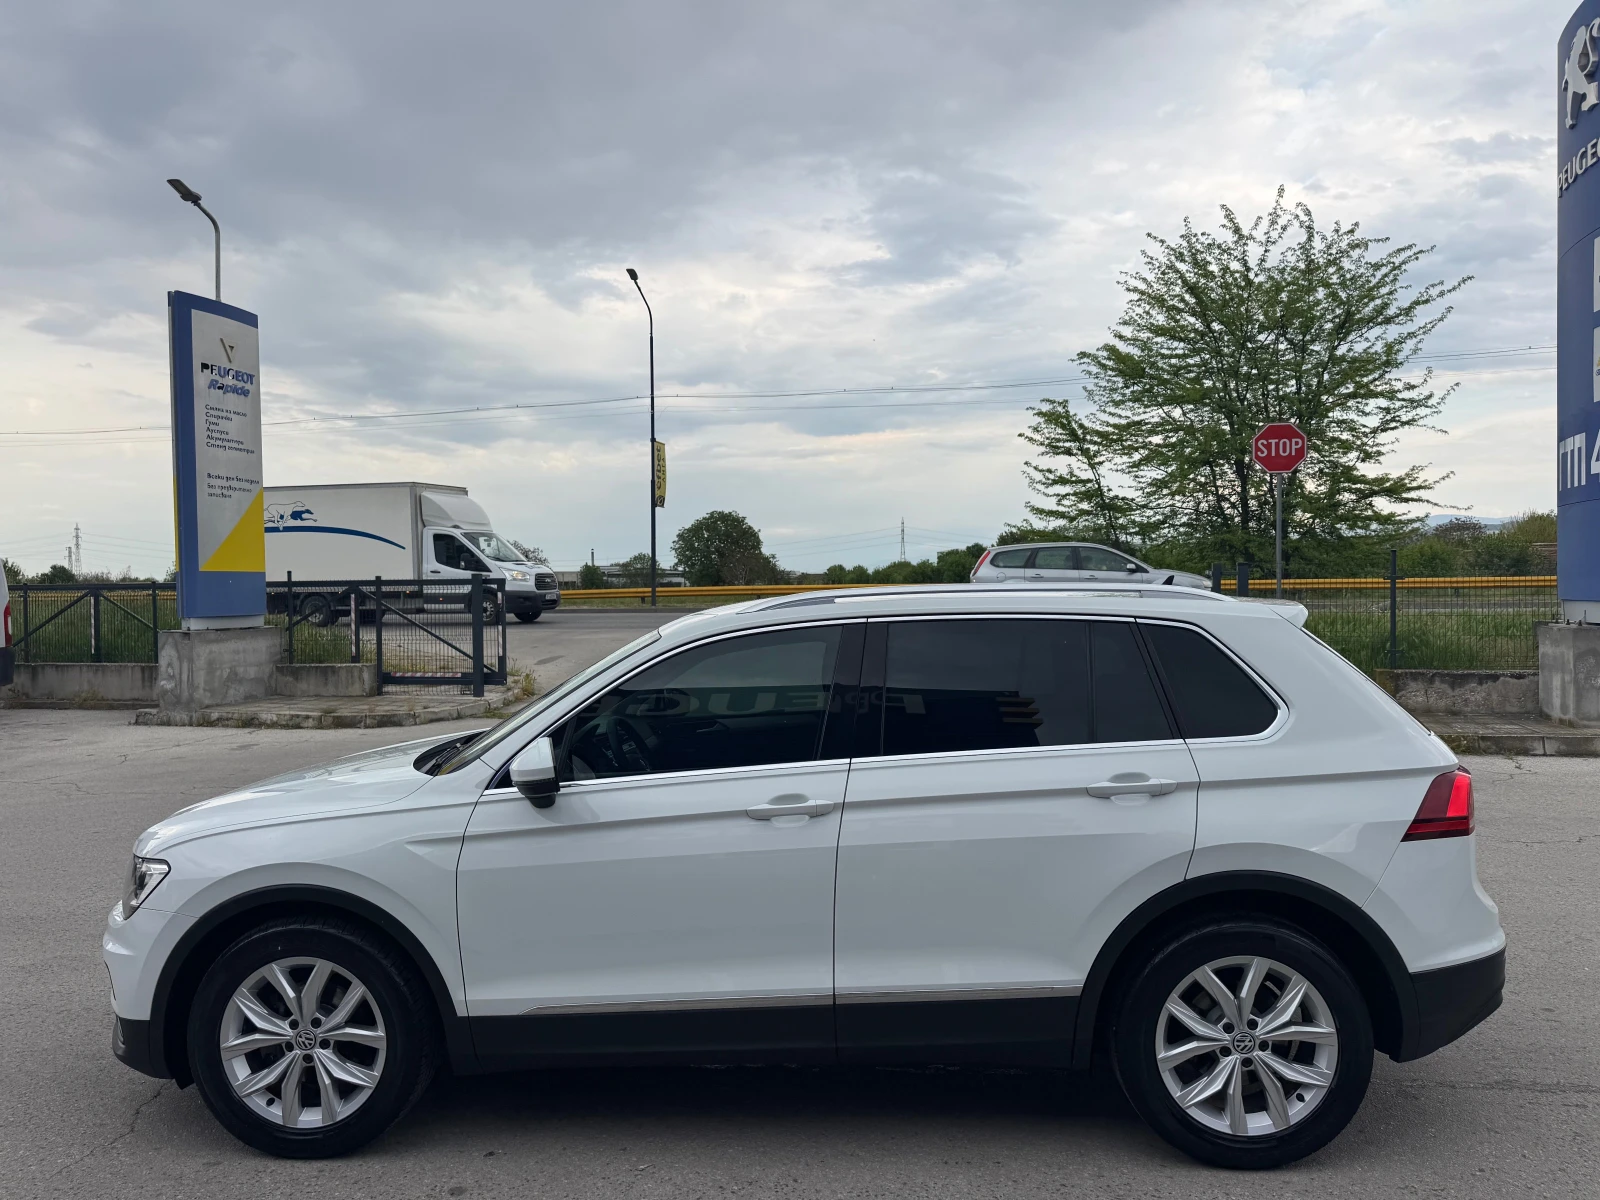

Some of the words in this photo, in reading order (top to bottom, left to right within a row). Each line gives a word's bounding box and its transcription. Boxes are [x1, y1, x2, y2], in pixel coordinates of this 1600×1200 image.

[1557, 136, 1600, 198] PEUGE
[201, 362, 255, 386] PEUGEOT
[207, 378, 251, 397] Rapide
[205, 418, 220, 427] Гуми
[1257, 438, 1303, 457] STOP
